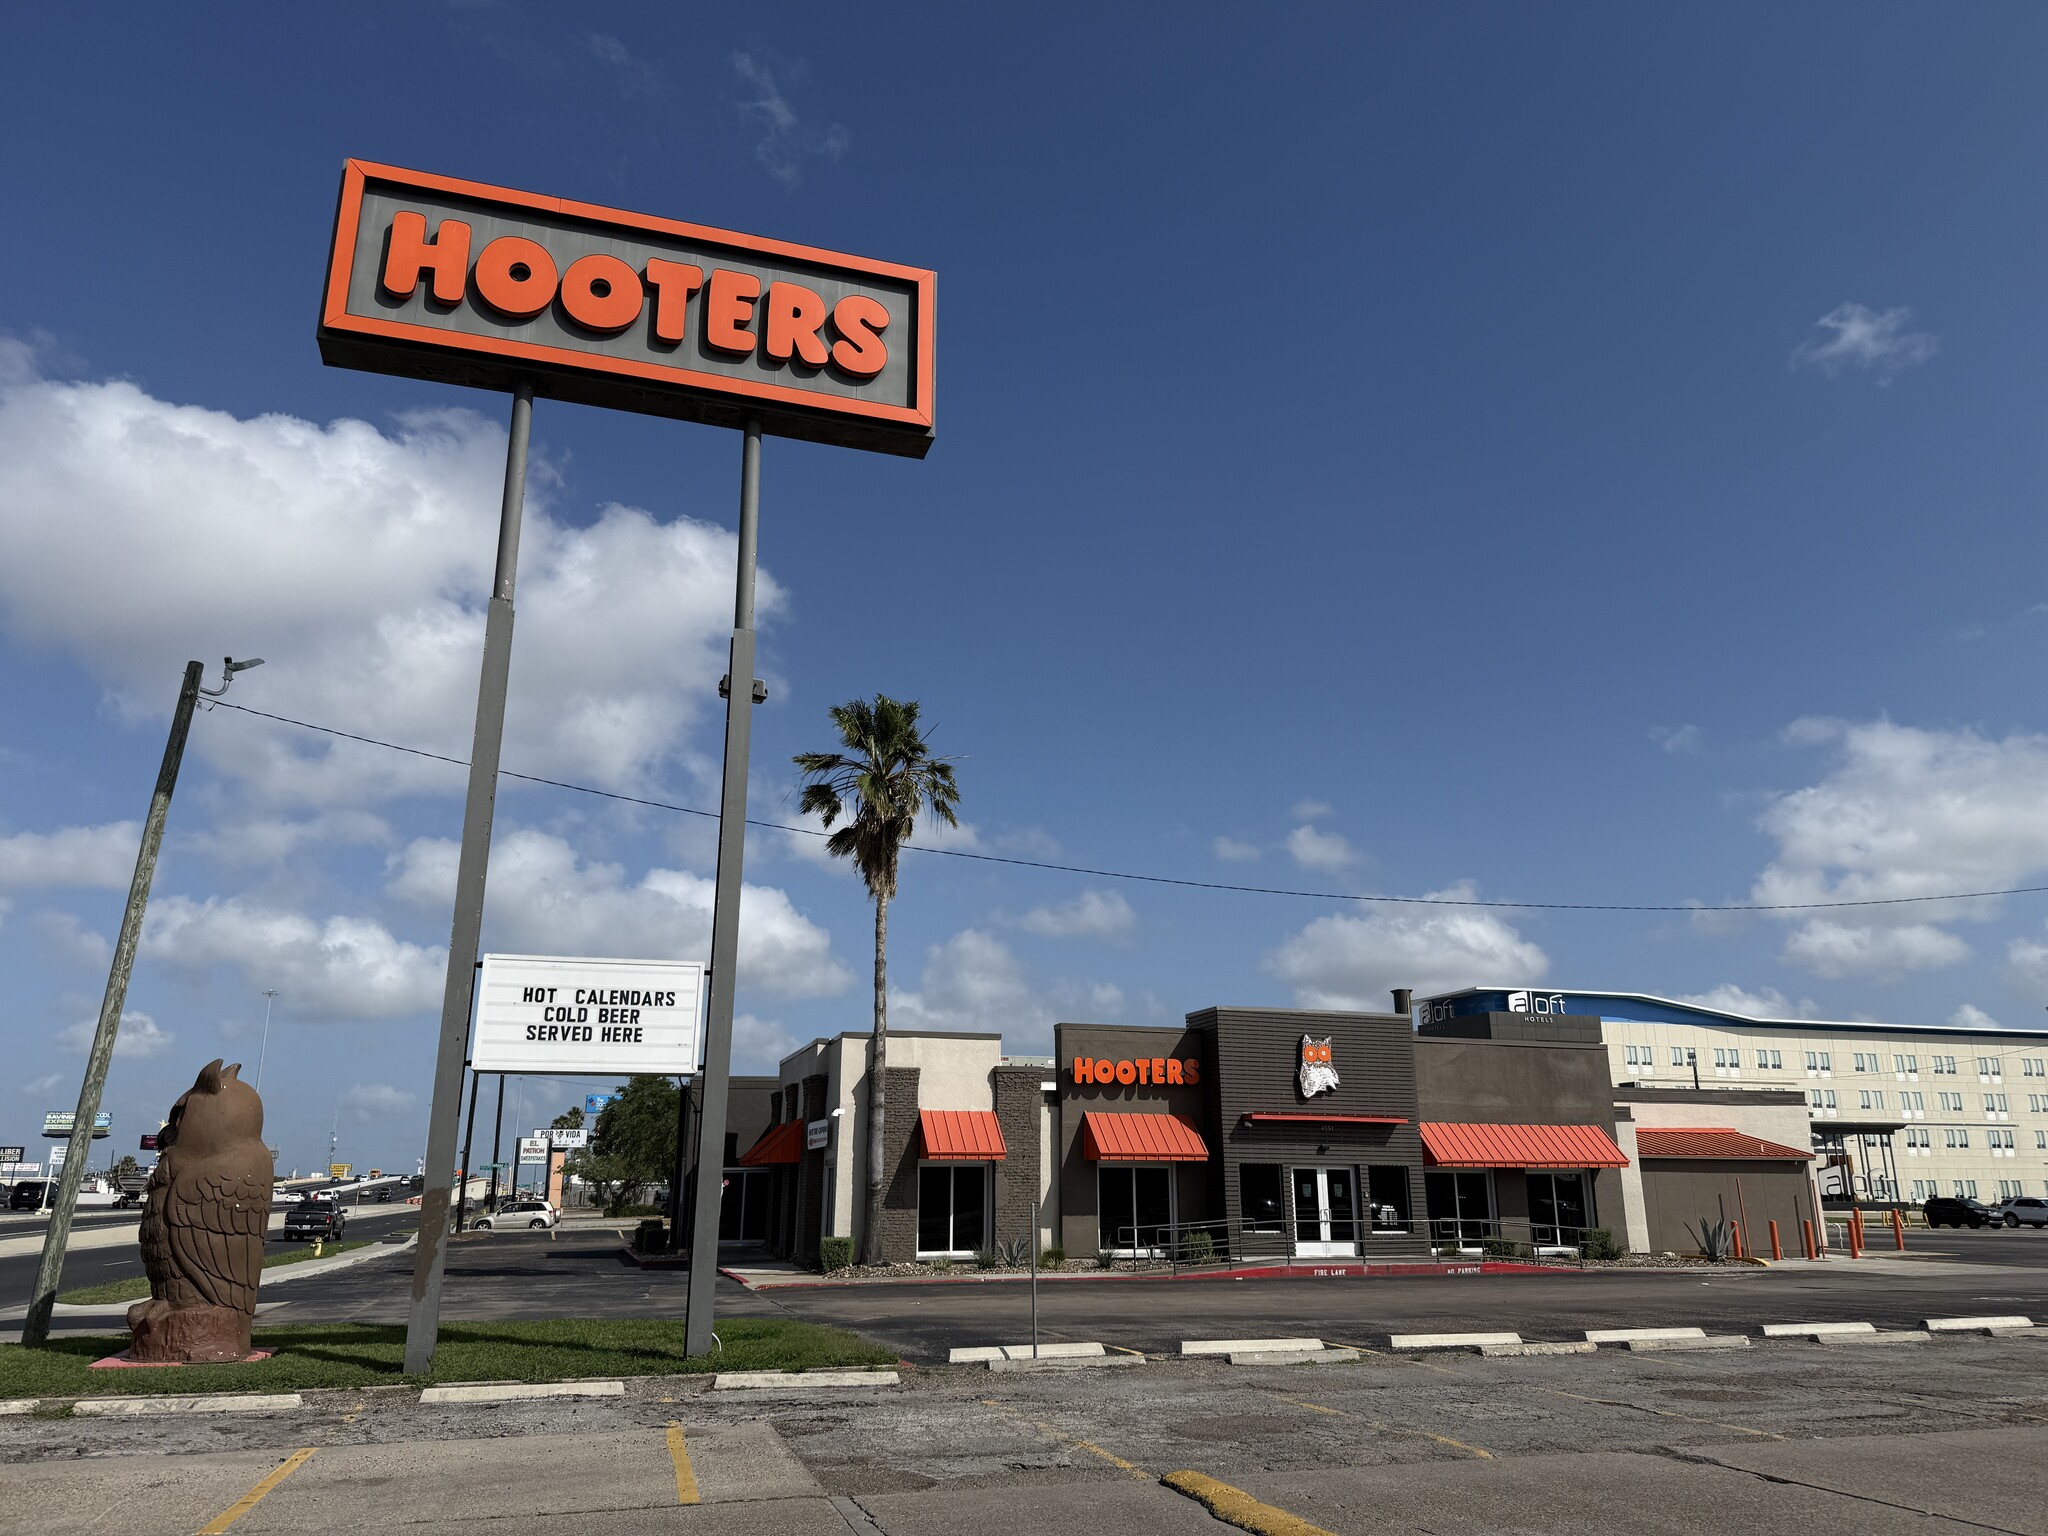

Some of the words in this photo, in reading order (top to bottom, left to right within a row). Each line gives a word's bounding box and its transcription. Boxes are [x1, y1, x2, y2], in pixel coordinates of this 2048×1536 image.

[382, 210, 891, 379] HOOTERS
[523, 987, 557, 1003] HOT
[575, 989, 676, 1006] CALENDARS
[1508, 990, 1566, 1015] aloft
[544, 1006, 588, 1023] COLD
[598, 1008, 640, 1024] BEER
[1524, 1016, 1554, 1024] HOTELS
[526, 1025, 593, 1042] SERVED
[601, 1027, 643, 1043] HERE
[1073, 1056, 1200, 1085] HOOTERS
